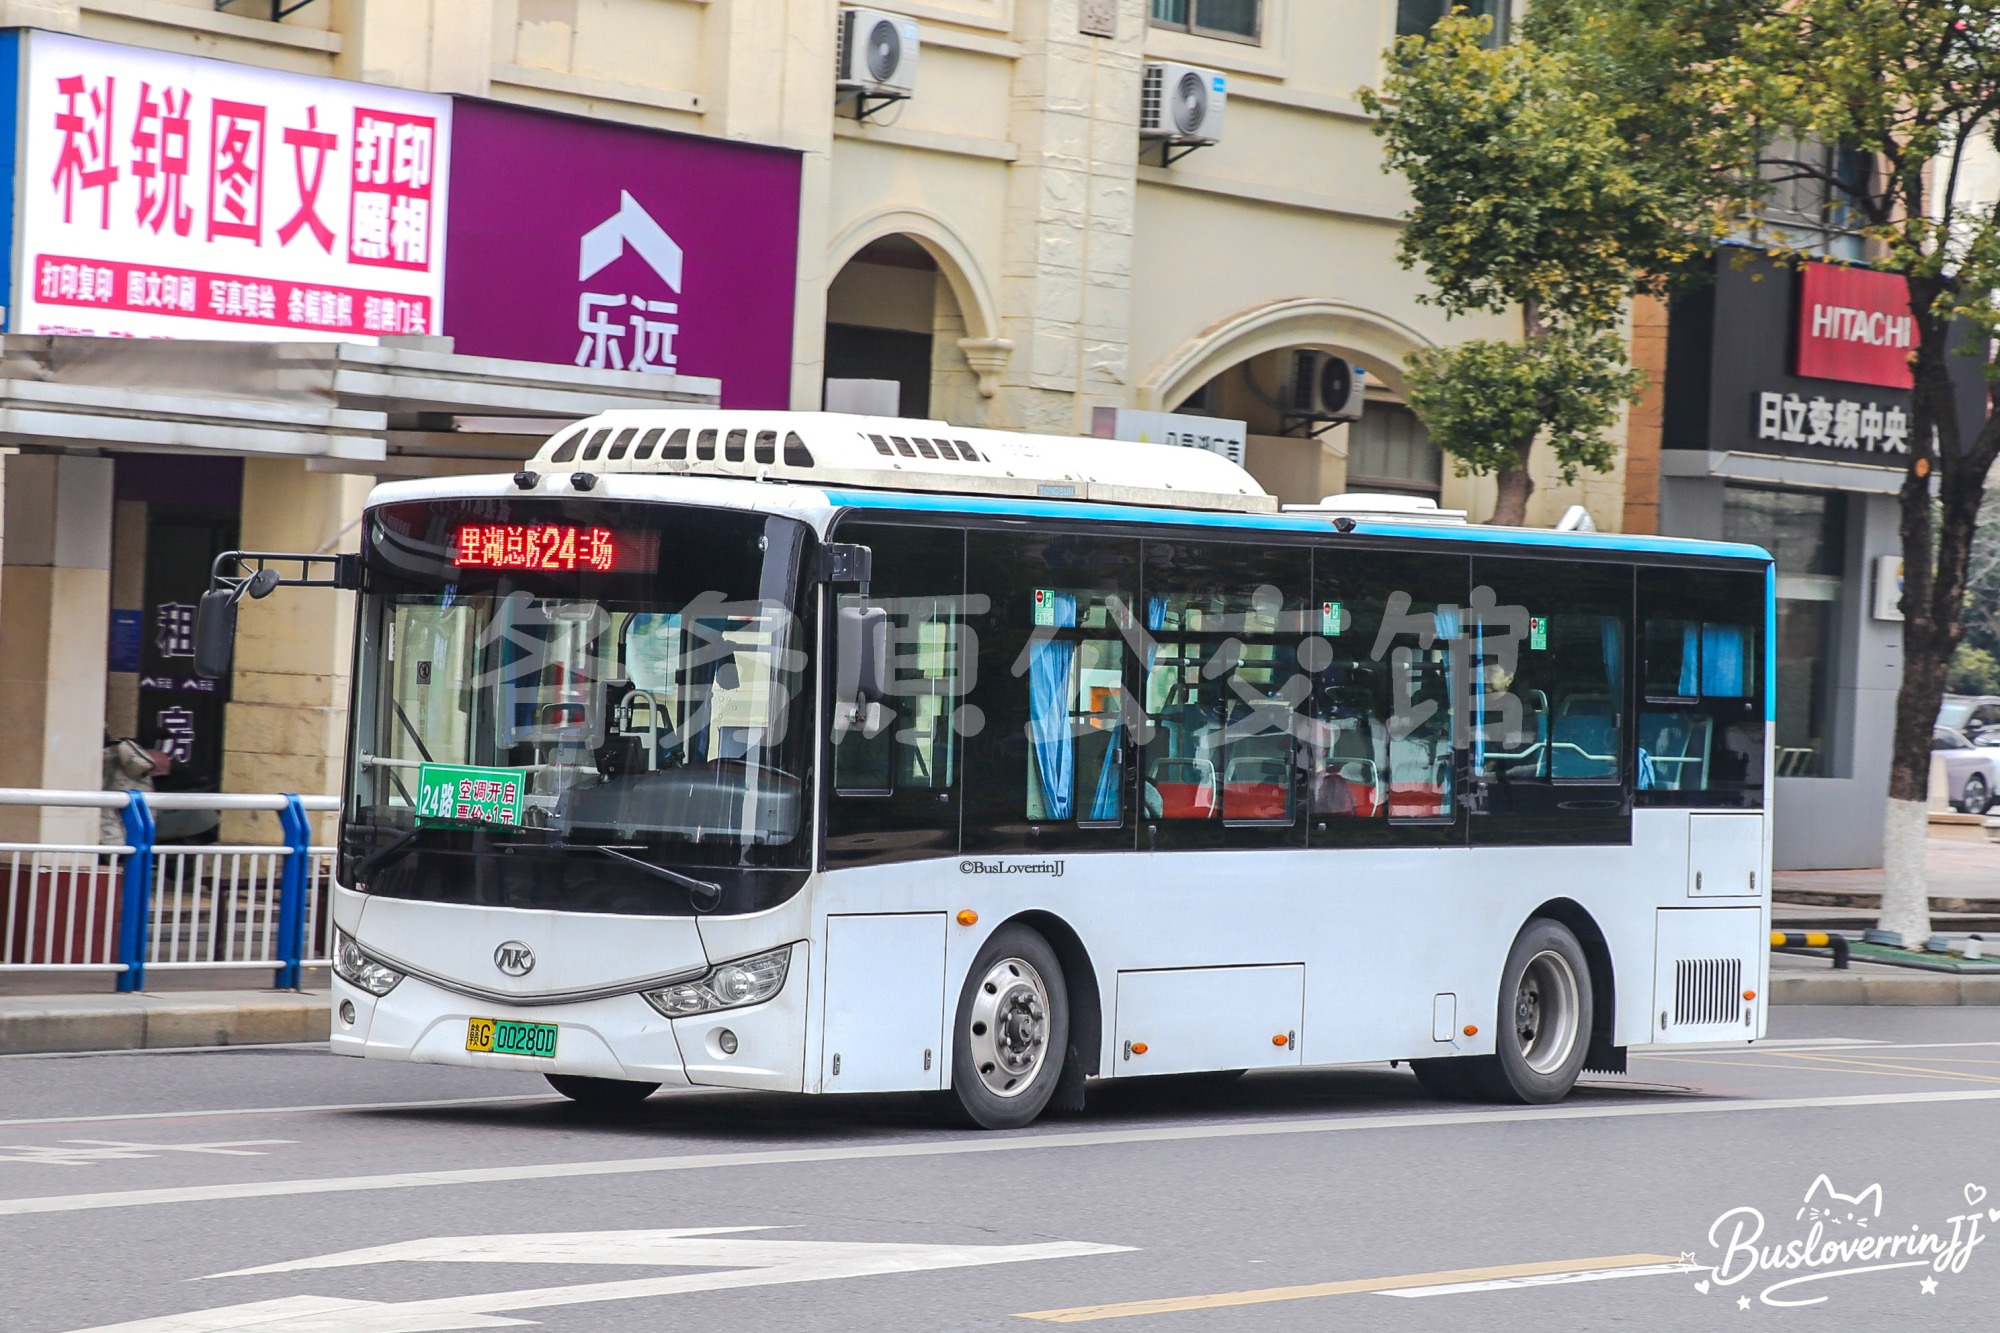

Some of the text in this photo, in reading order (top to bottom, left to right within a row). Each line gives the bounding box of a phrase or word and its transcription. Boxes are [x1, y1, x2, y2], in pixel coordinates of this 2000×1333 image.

[52, 74, 338, 255] 科锐图文
[355, 116, 432, 190] 打印
[351, 191, 429, 264] 照相
[41, 260, 114, 303] 打印复印
[126, 270, 197, 312] 图文印刷
[208, 279, 276, 320] 写真喷绘
[363, 295, 427, 334] 招牌门头
[574, 291, 680, 375] 乐远
[1812, 304, 1911, 347] HITACHI
[1759, 391, 1941, 457] 日立变频中央
[421, 783, 455, 818] 24路
[458, 778, 516, 805] 空调开启
